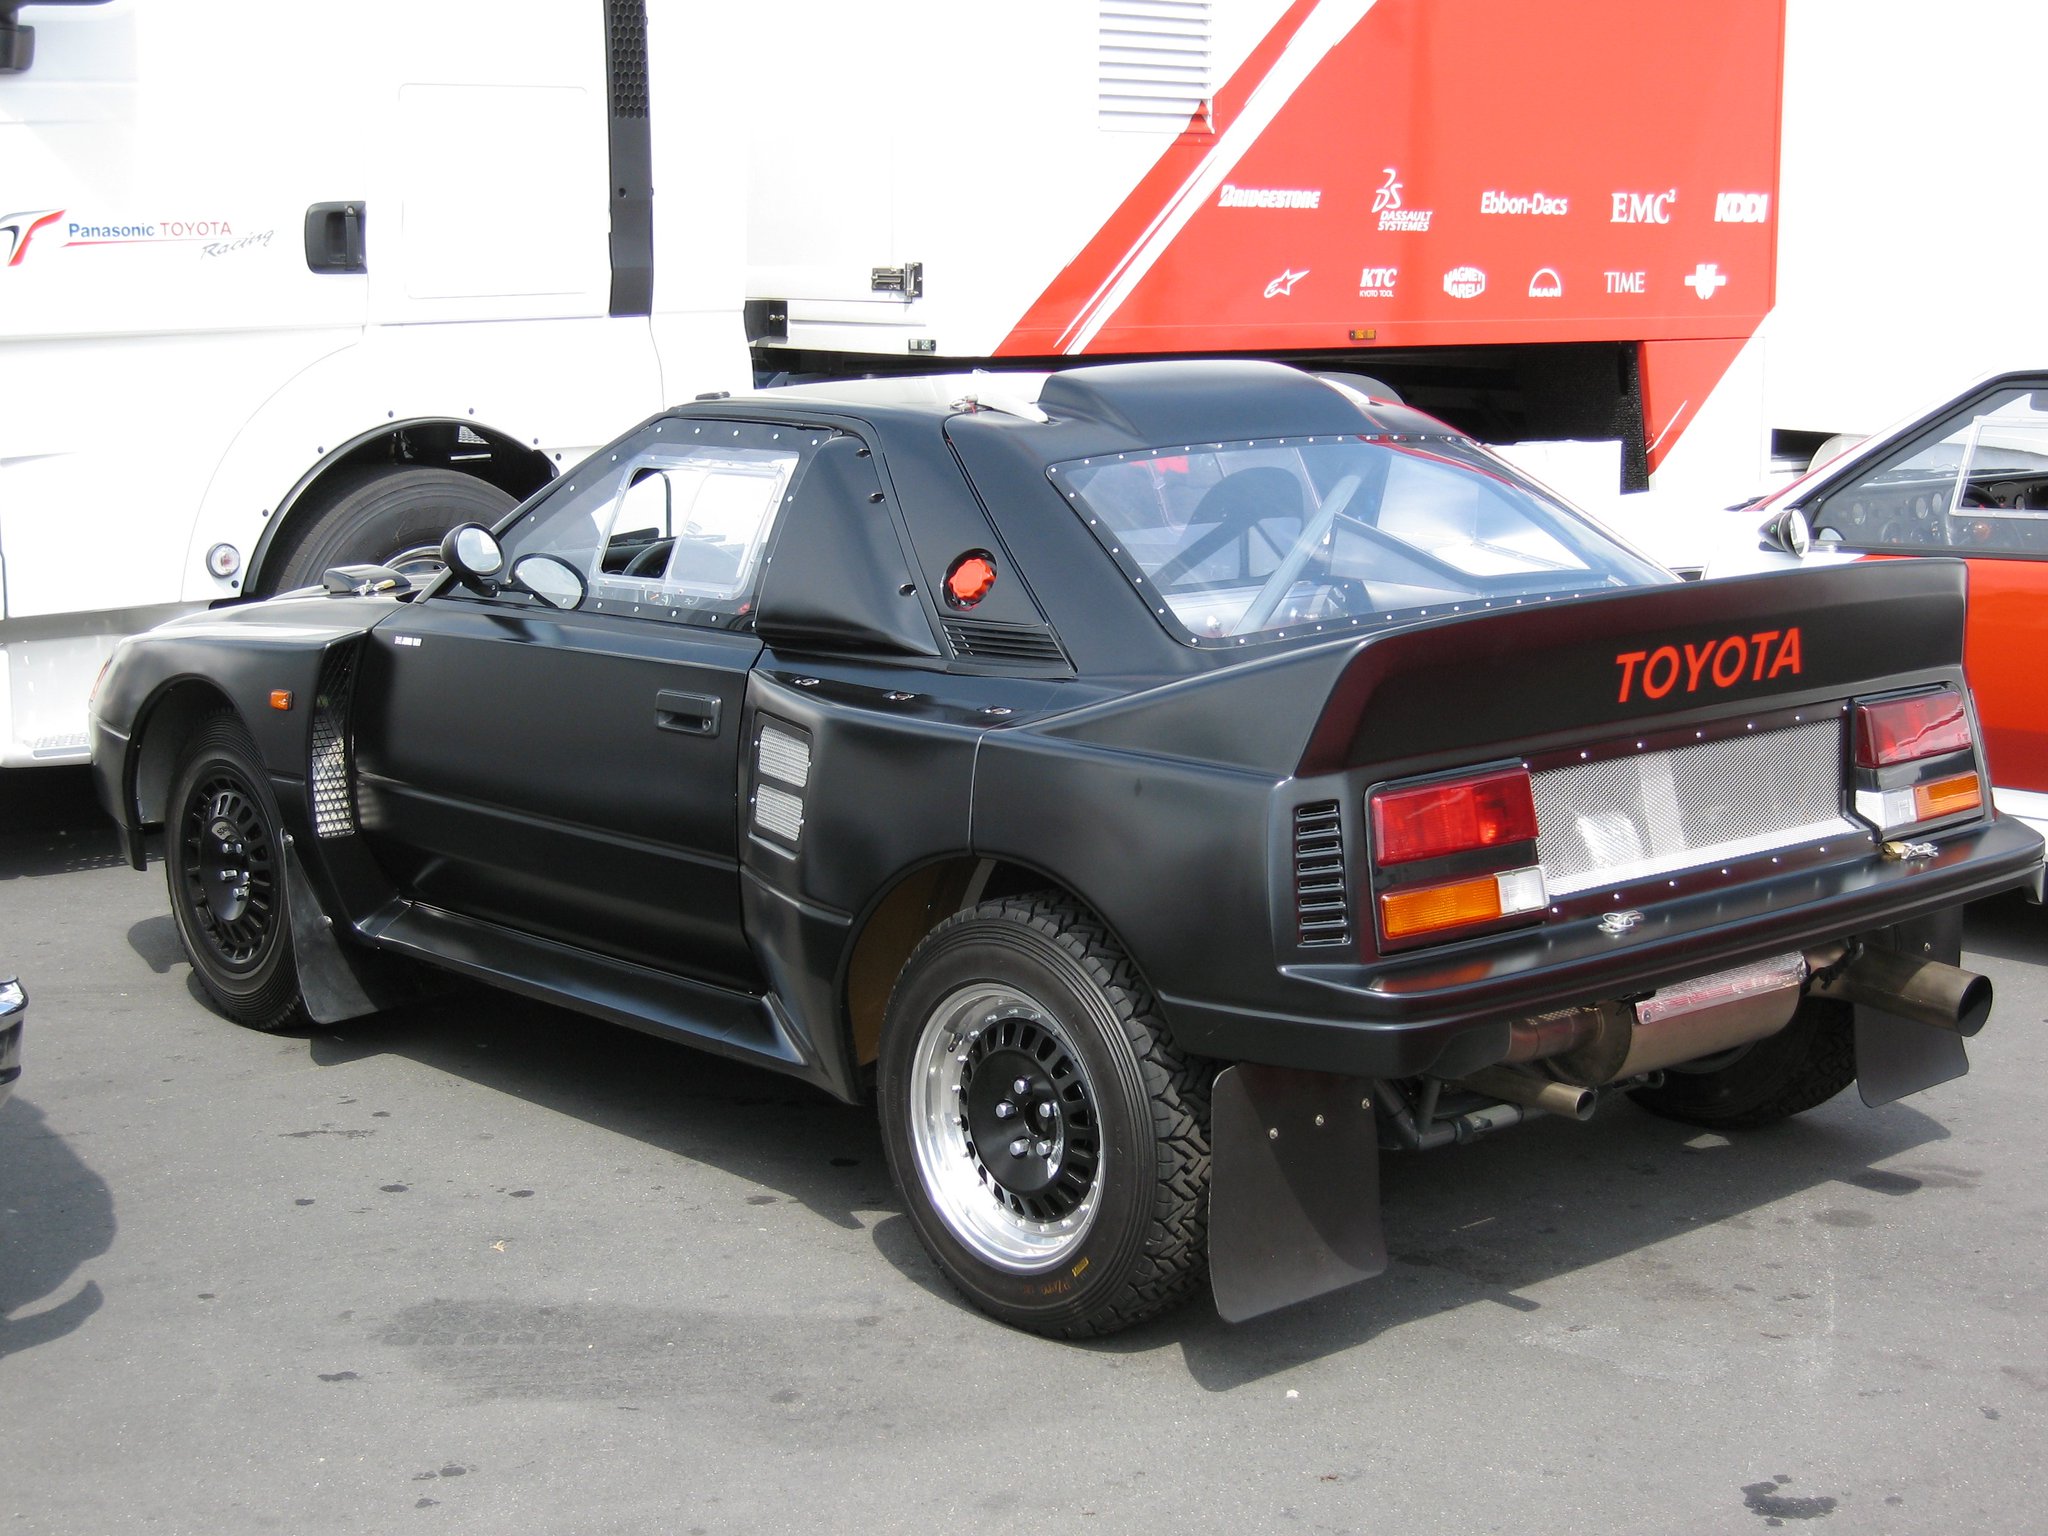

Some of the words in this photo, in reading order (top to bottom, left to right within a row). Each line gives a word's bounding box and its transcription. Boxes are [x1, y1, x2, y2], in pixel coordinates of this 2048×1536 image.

[1218, 184, 1321, 208] BRIDGESTONE
[1480, 191, 1568, 215] Ebbon-Dacs
[1380, 211, 1432, 222] DASSAULT
[1714, 193, 1768, 223] KDDI
[69, 223, 155, 237] Panasonic
[160, 222, 232, 236] TOYOTA
[201, 229, 275, 259] Racing
[1360, 268, 1397, 287] KTC
[1604, 272, 1646, 294] TIME
[1379, 290, 1394, 298] TOOL
[1616, 627, 1802, 703] TOYOTA
